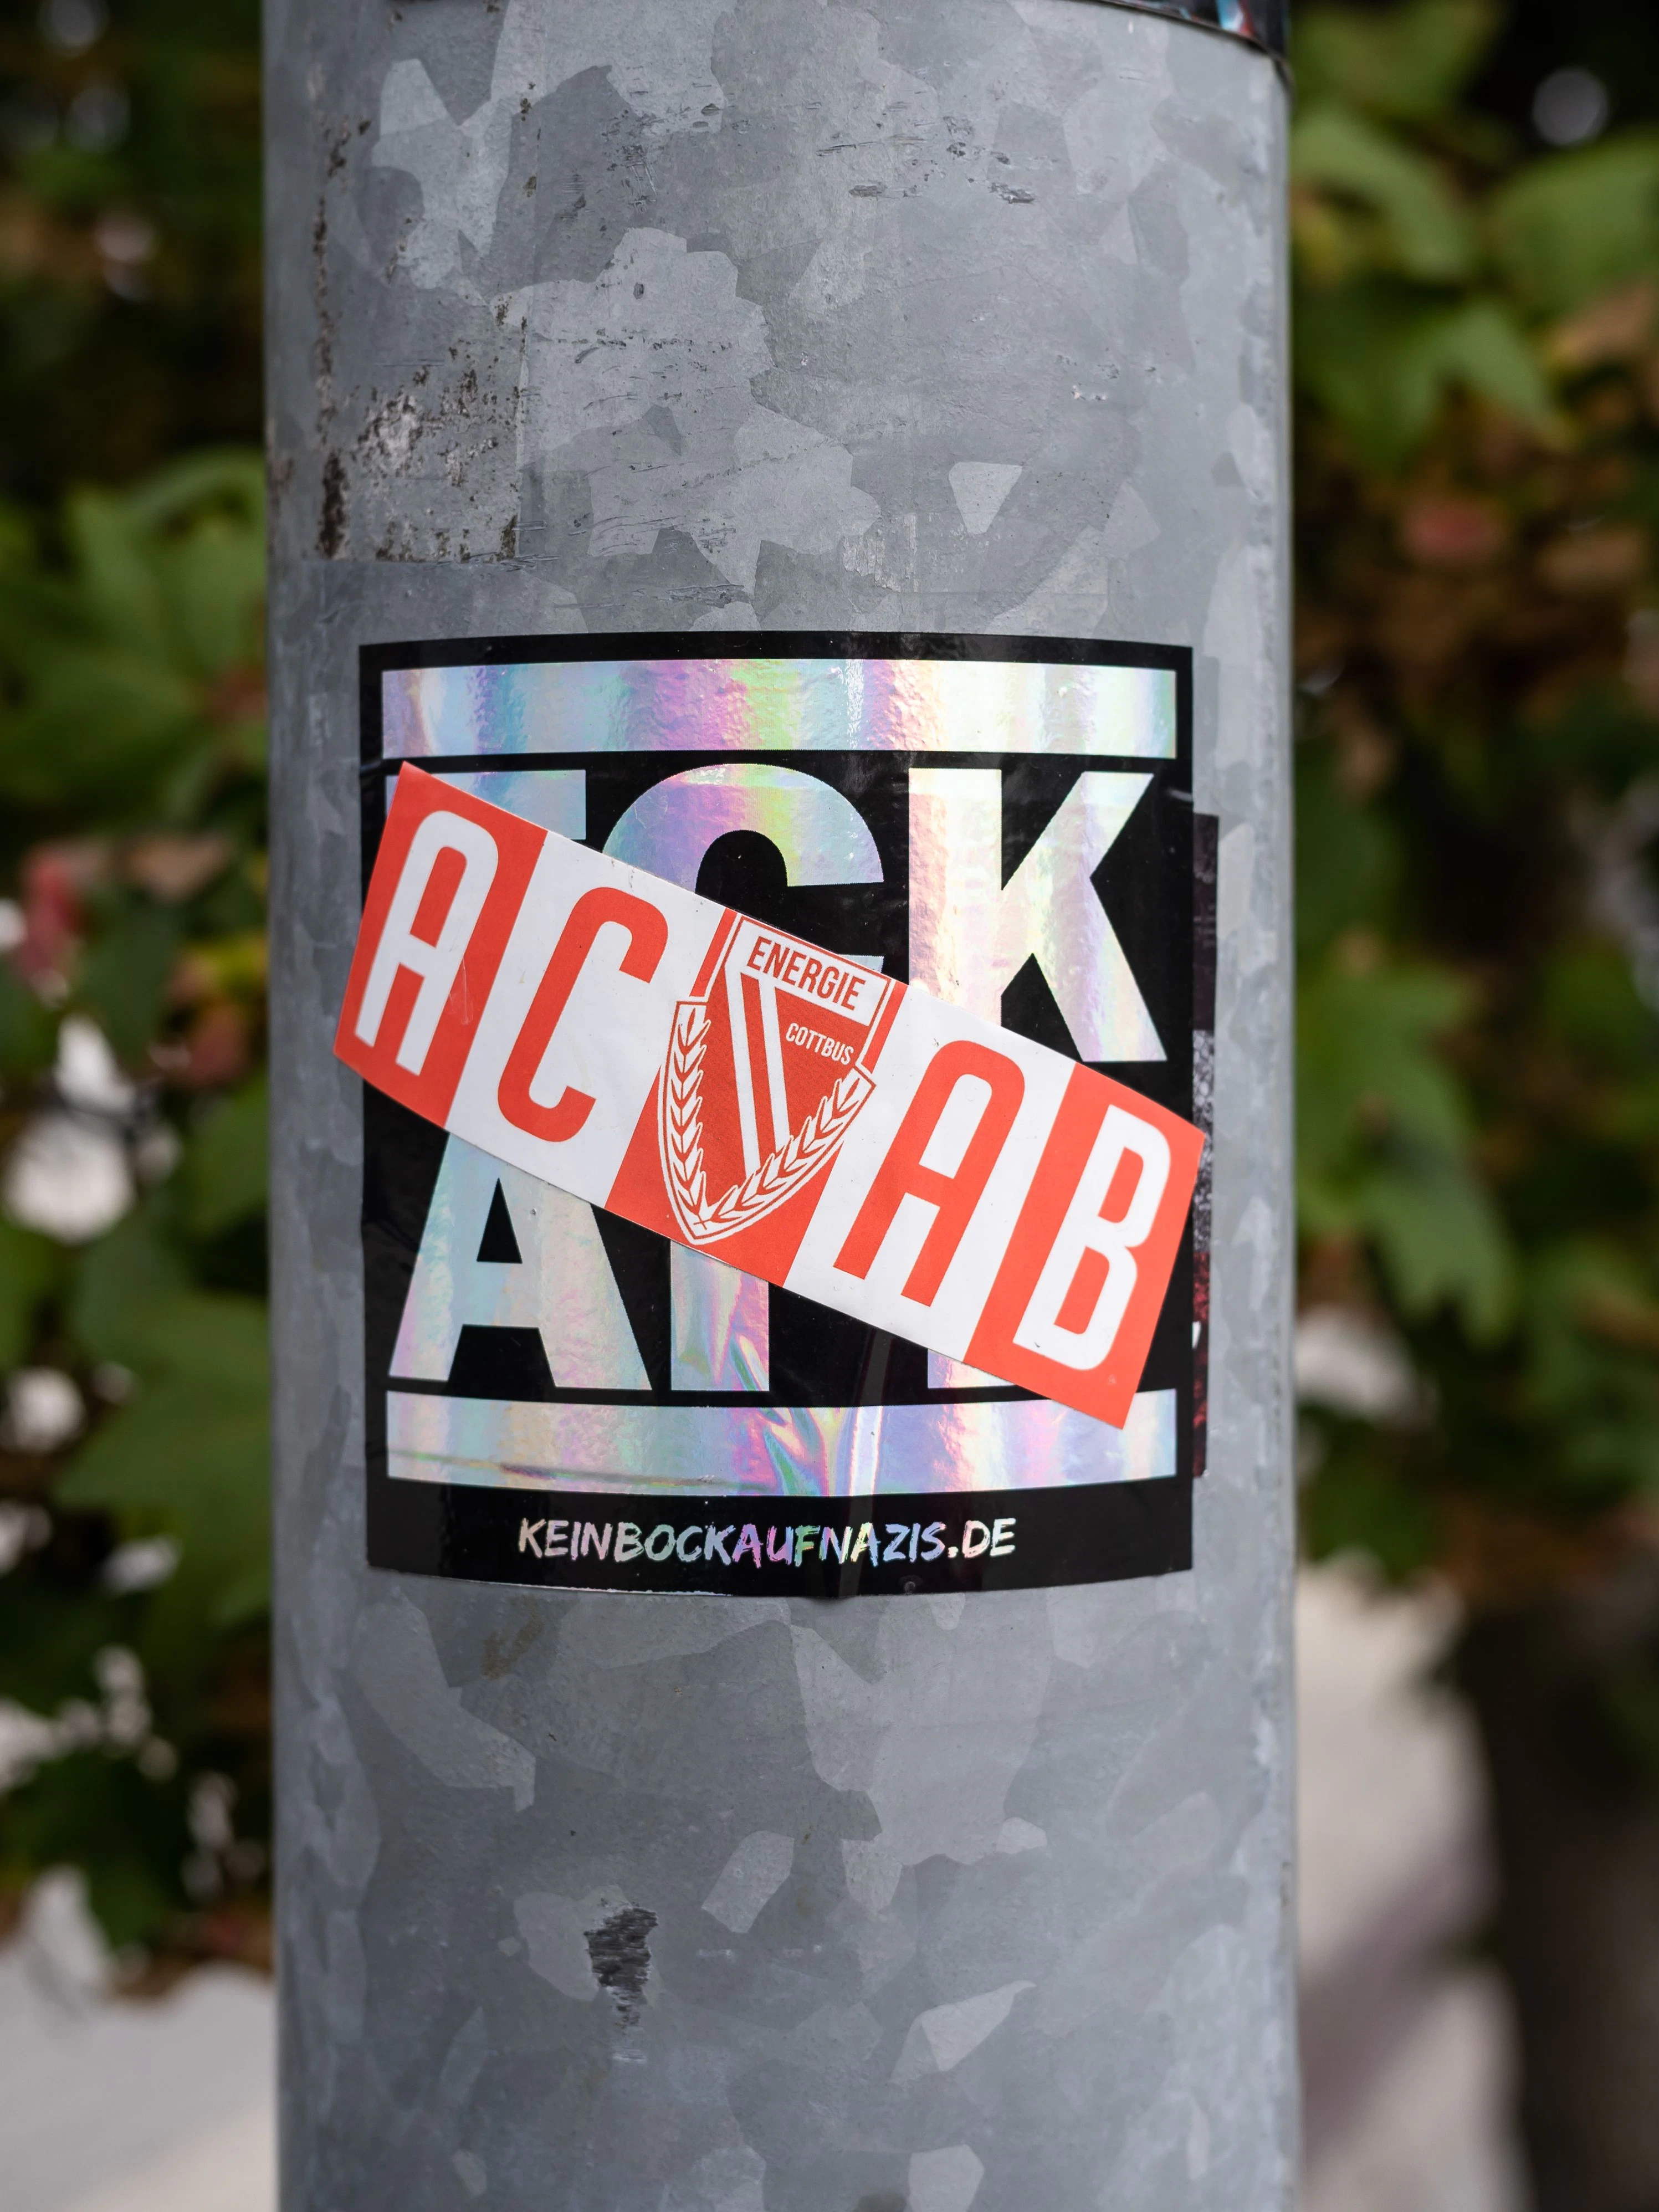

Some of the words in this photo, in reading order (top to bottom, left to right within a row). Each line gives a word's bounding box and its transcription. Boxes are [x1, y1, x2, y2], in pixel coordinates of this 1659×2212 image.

[747, 936, 866, 1011] ENERGIE
[785, 1022, 854, 1066] COTTBUS
[519, 1518, 1016, 1568] KEINBOCKAUFNAZIS.DE
